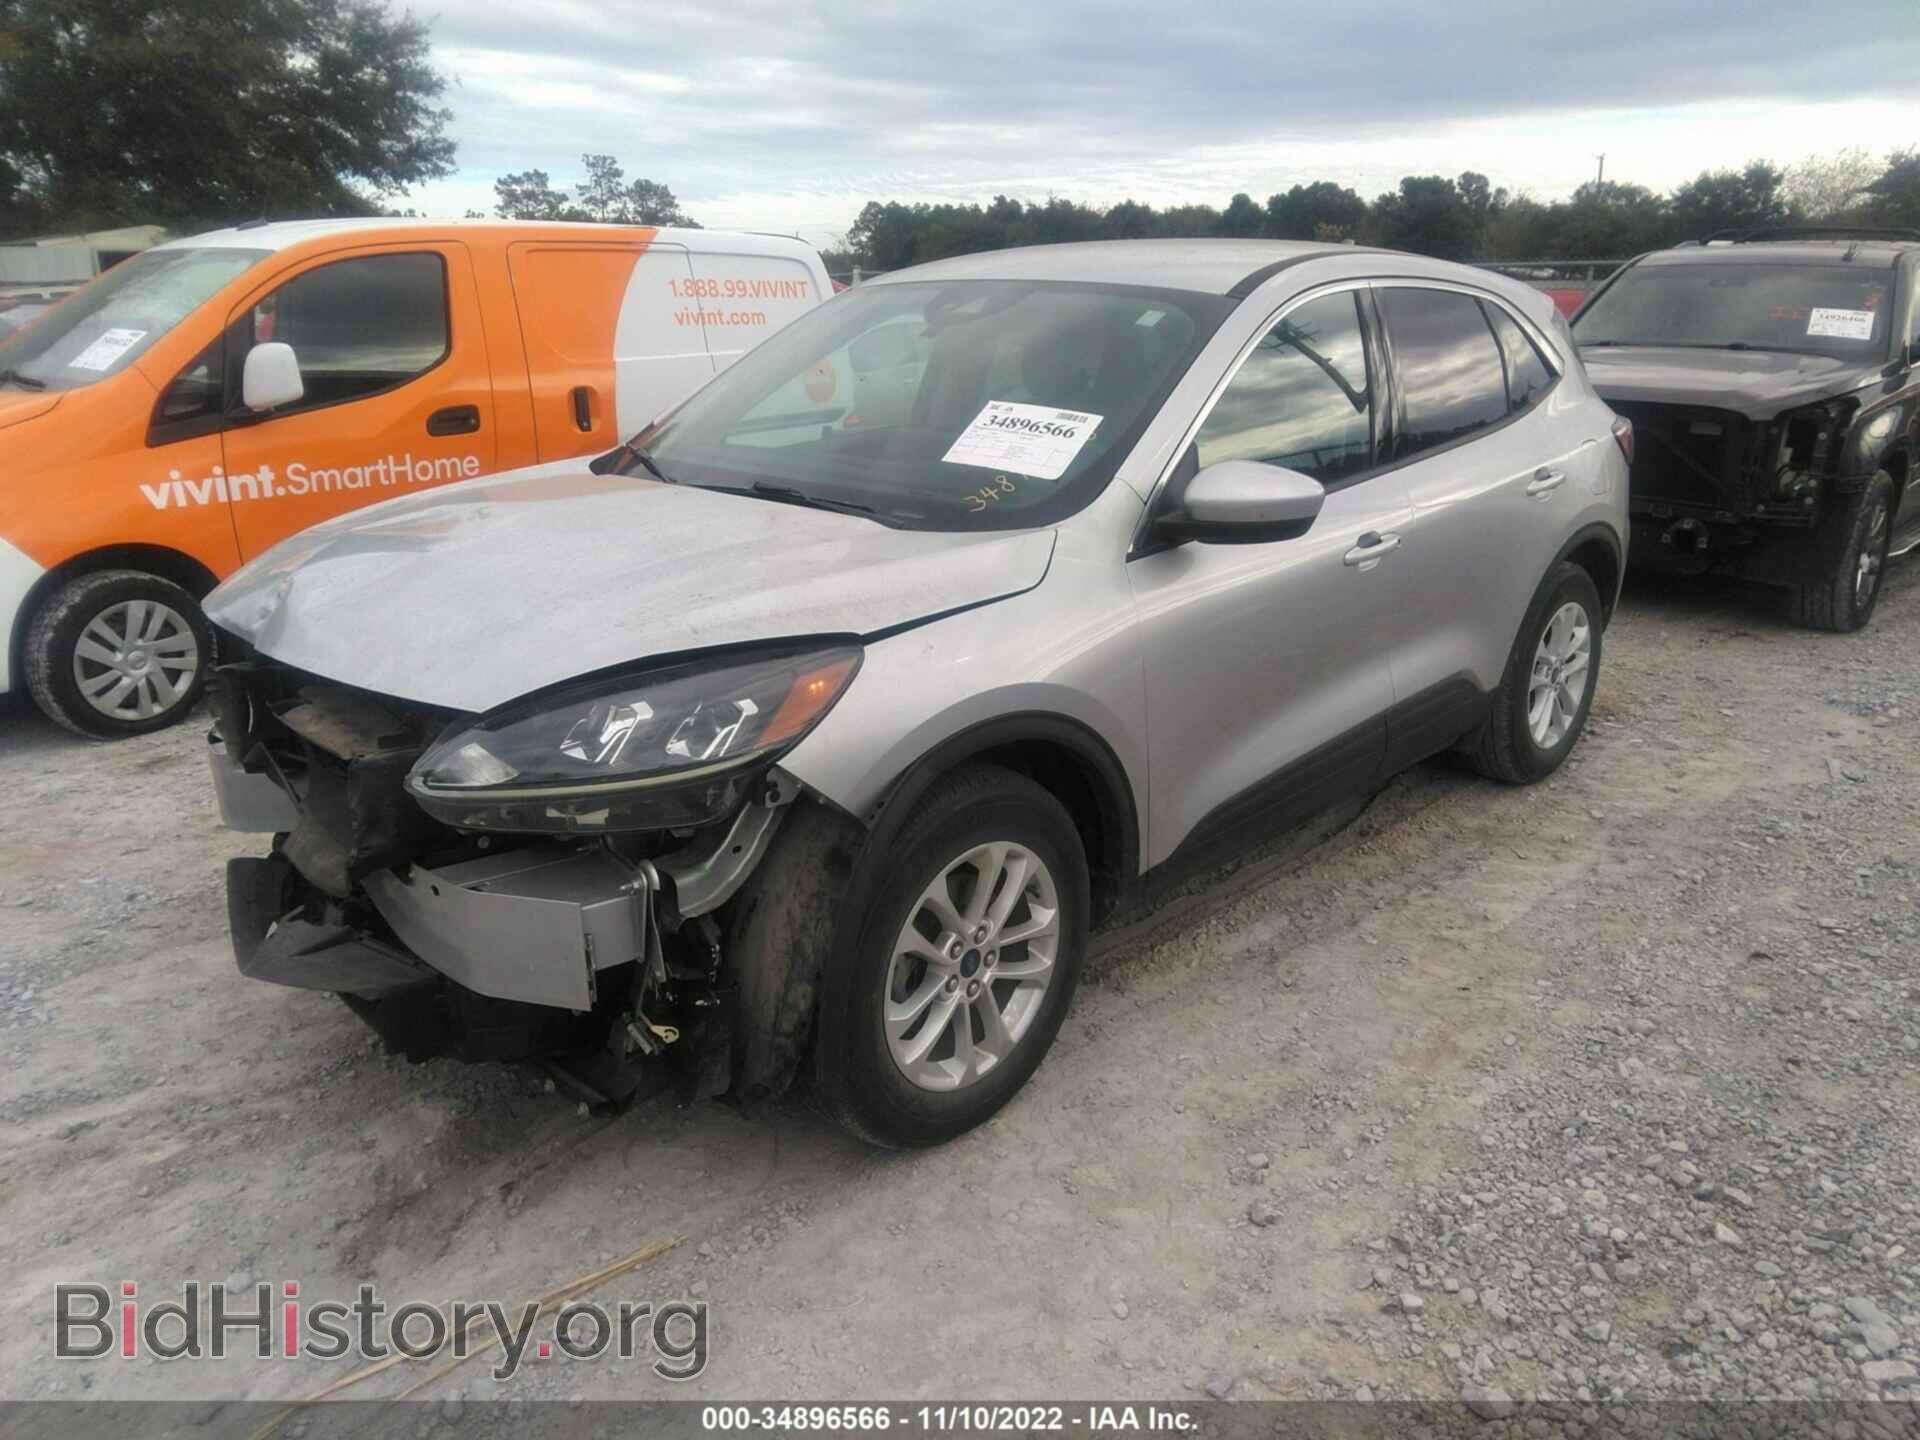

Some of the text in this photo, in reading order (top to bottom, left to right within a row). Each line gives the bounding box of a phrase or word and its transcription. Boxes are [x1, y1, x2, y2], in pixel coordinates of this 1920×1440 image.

[668, 279, 808, 299] 1.888.99.VIVINT
[674, 306, 766, 327] vivint.com
[983, 414, 1077, 440] 34896566
